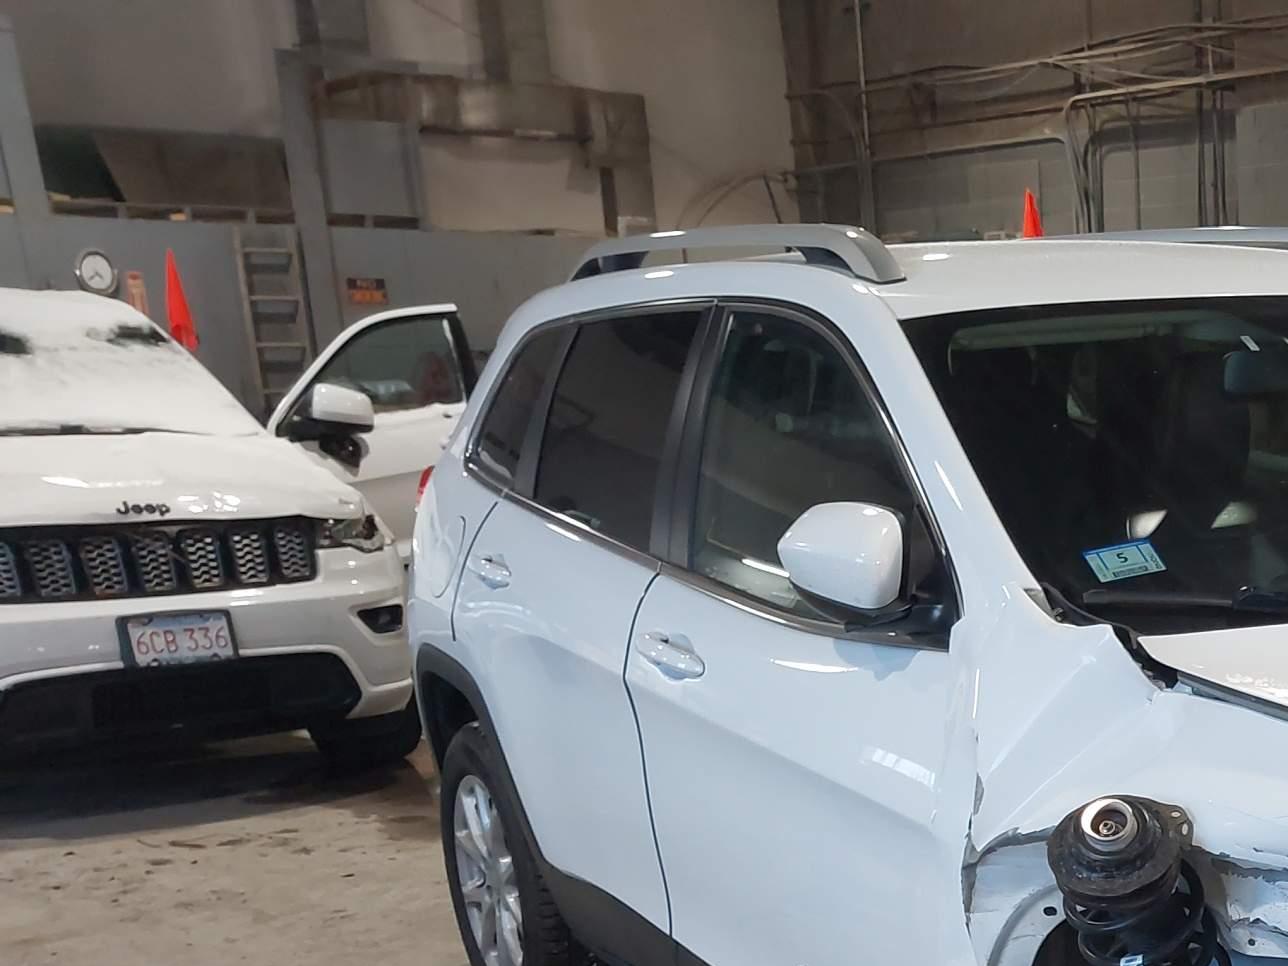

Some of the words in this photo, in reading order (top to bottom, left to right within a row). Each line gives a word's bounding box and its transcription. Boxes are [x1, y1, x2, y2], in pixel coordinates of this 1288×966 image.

[116, 501, 170, 516] Jeep
[136, 628, 178, 655] 6CB
[183, 626, 228, 651] 336
